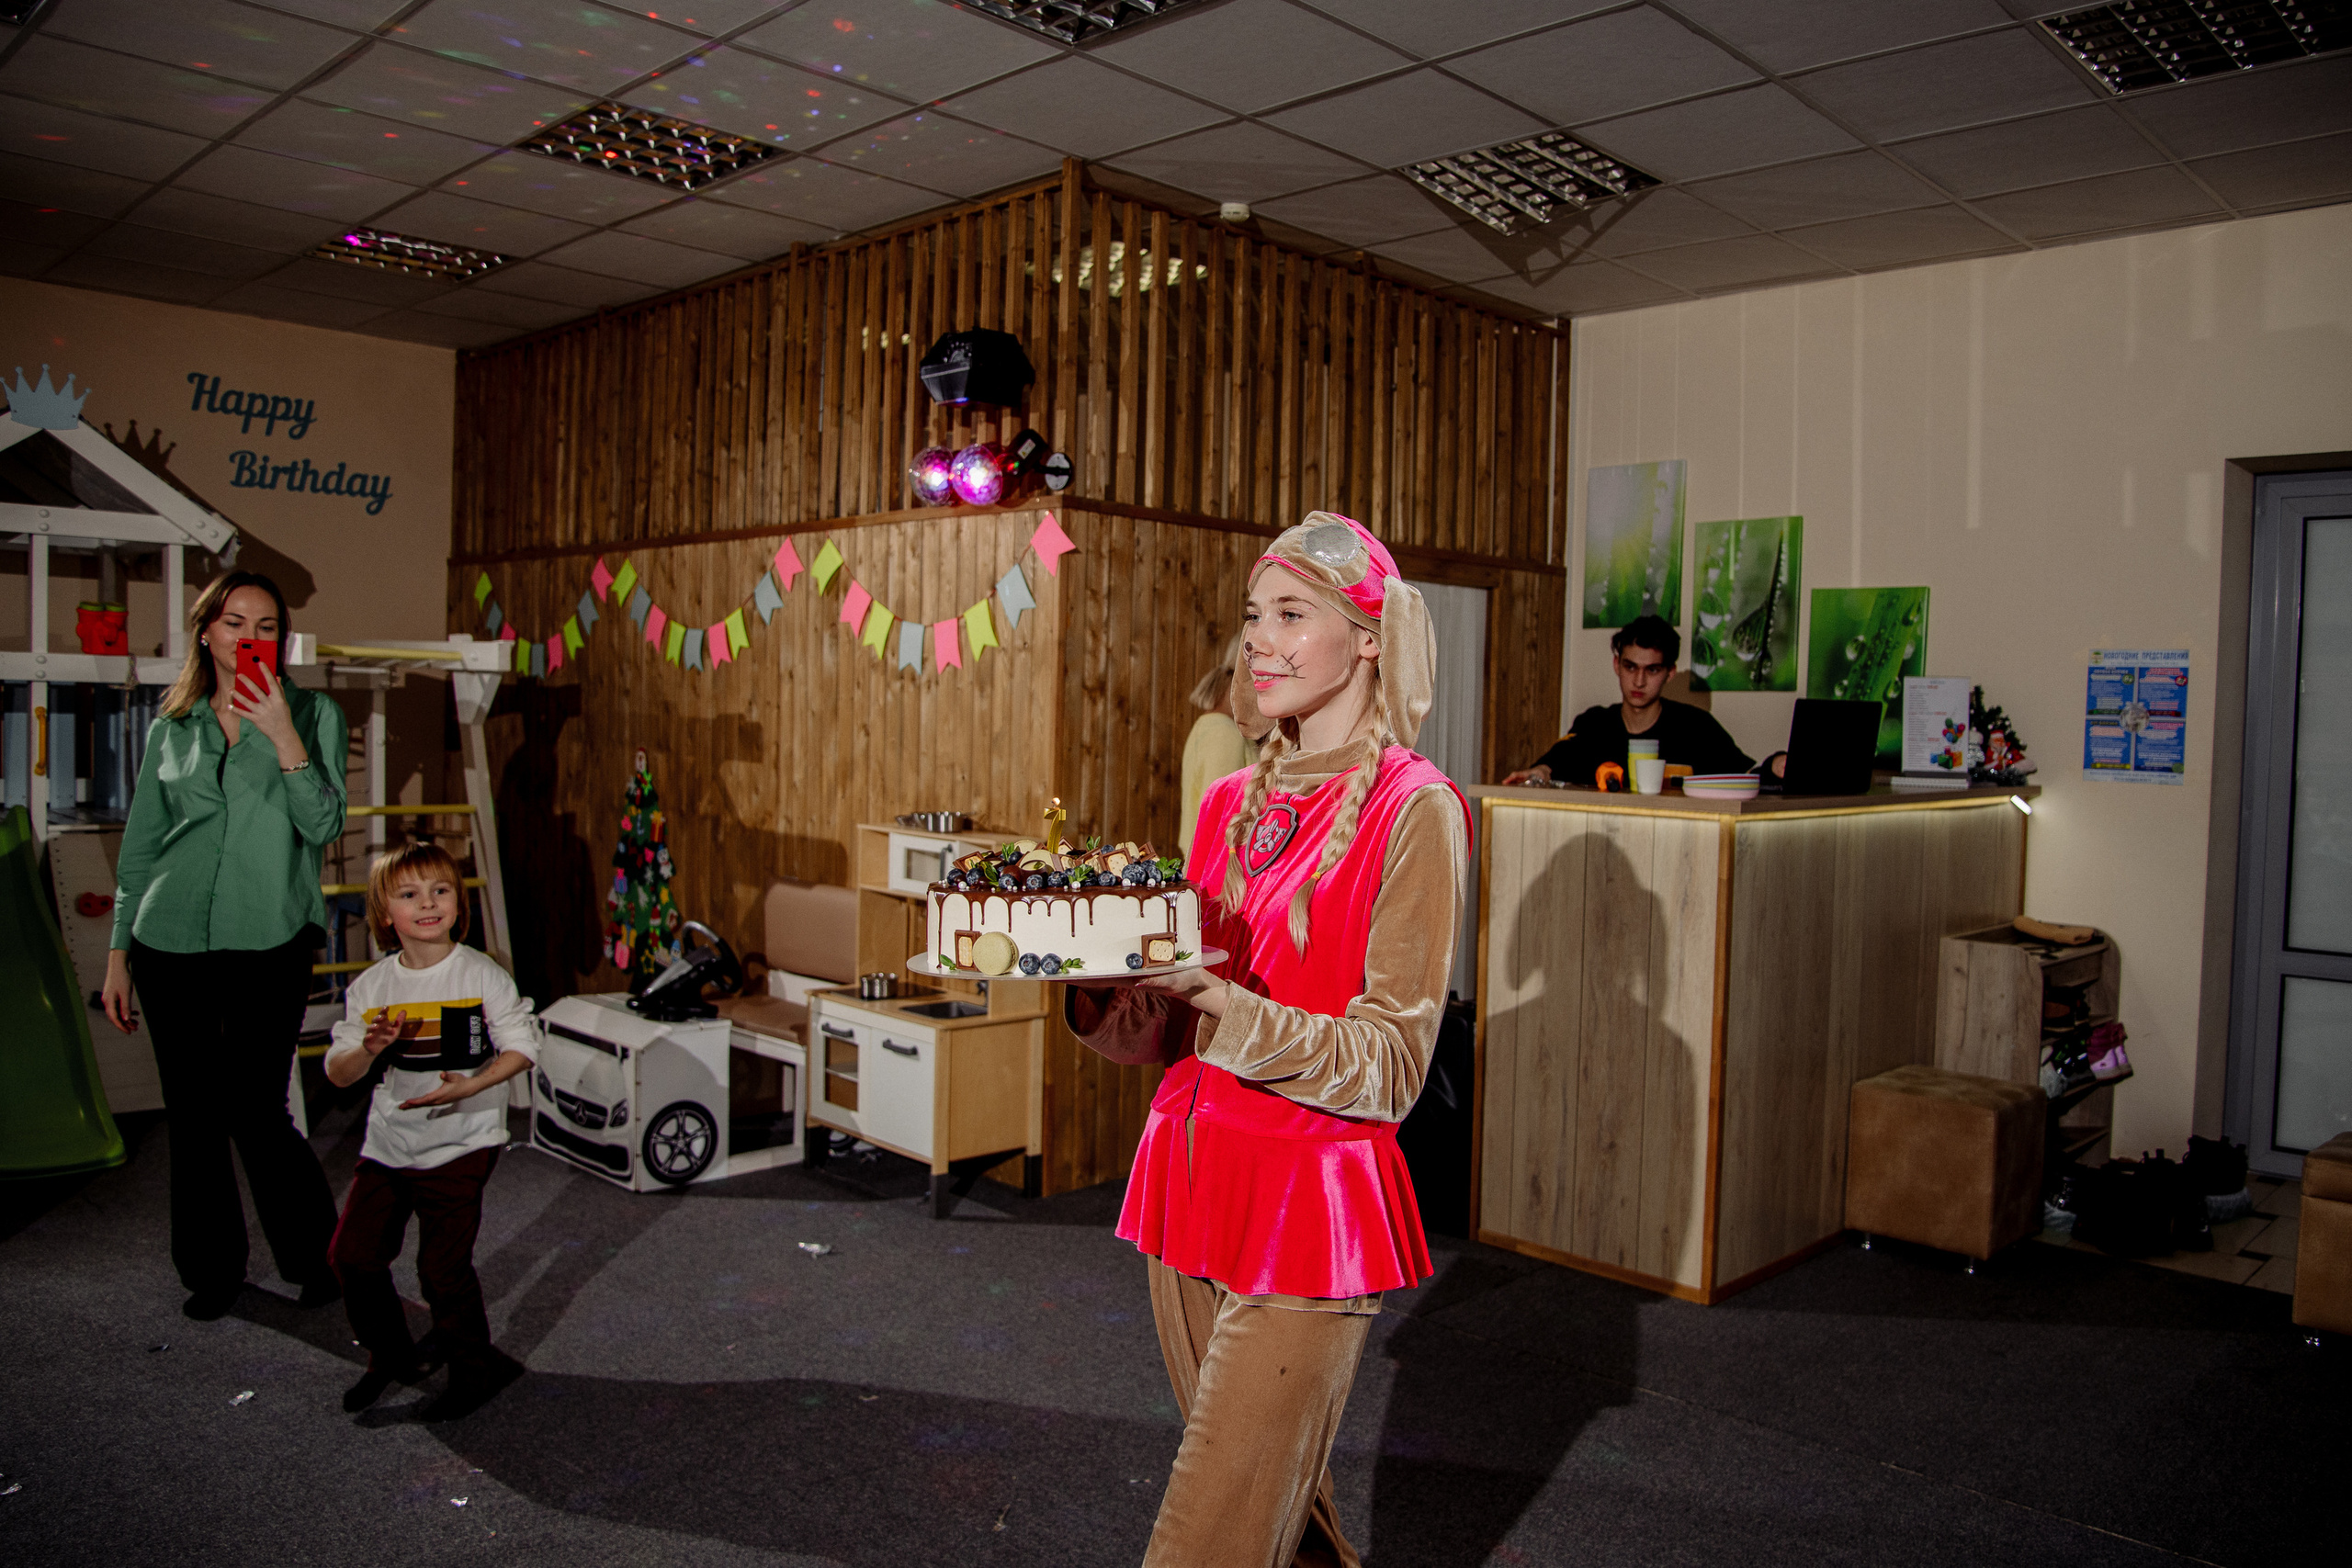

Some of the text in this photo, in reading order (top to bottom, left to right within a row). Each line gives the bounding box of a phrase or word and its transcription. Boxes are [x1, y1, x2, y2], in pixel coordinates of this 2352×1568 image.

[187, 372, 317, 440] Happy
[229, 450, 393, 515] Birthday
[2103, 651, 2188, 660] НОВОГОДНИЕ ПРЕДСТАВЛЕНИЯ
